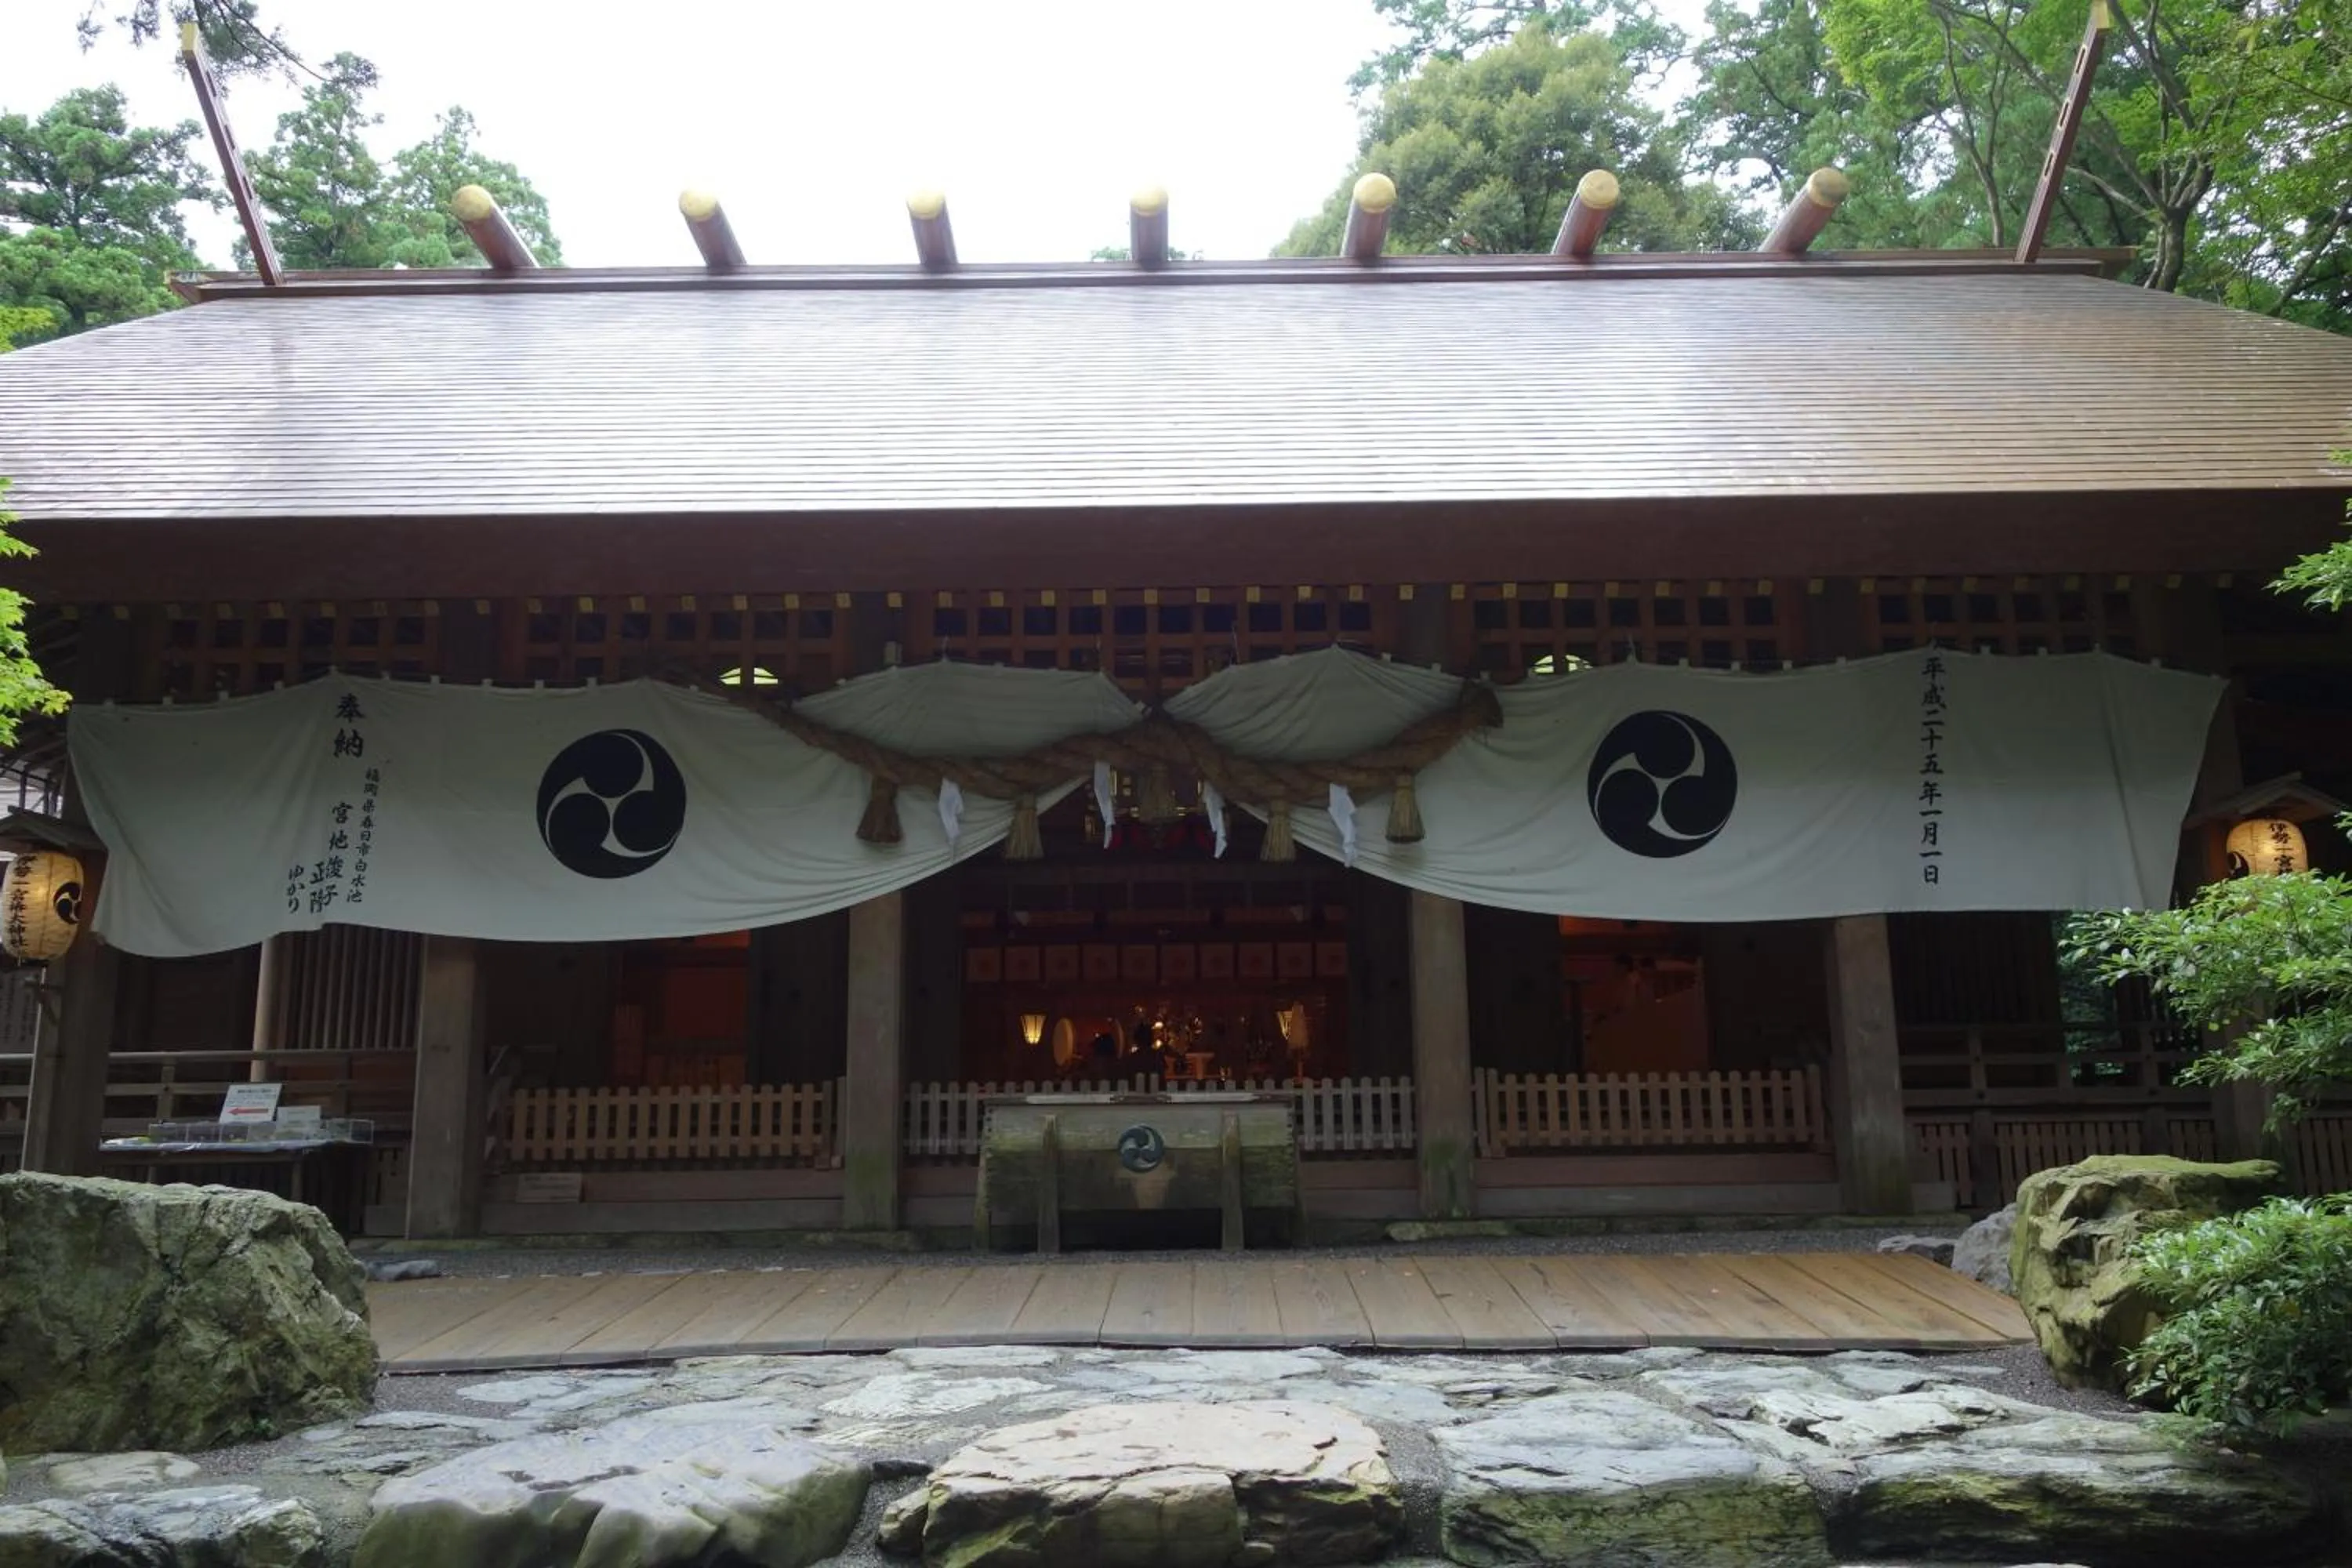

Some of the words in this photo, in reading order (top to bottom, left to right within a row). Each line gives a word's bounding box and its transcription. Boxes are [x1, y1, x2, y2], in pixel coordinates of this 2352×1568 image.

[333, 692, 366, 759] 奉納
[1919, 657, 1947, 884] 平成二十五年一月一日
[286, 865, 306, 914] ゆかり
